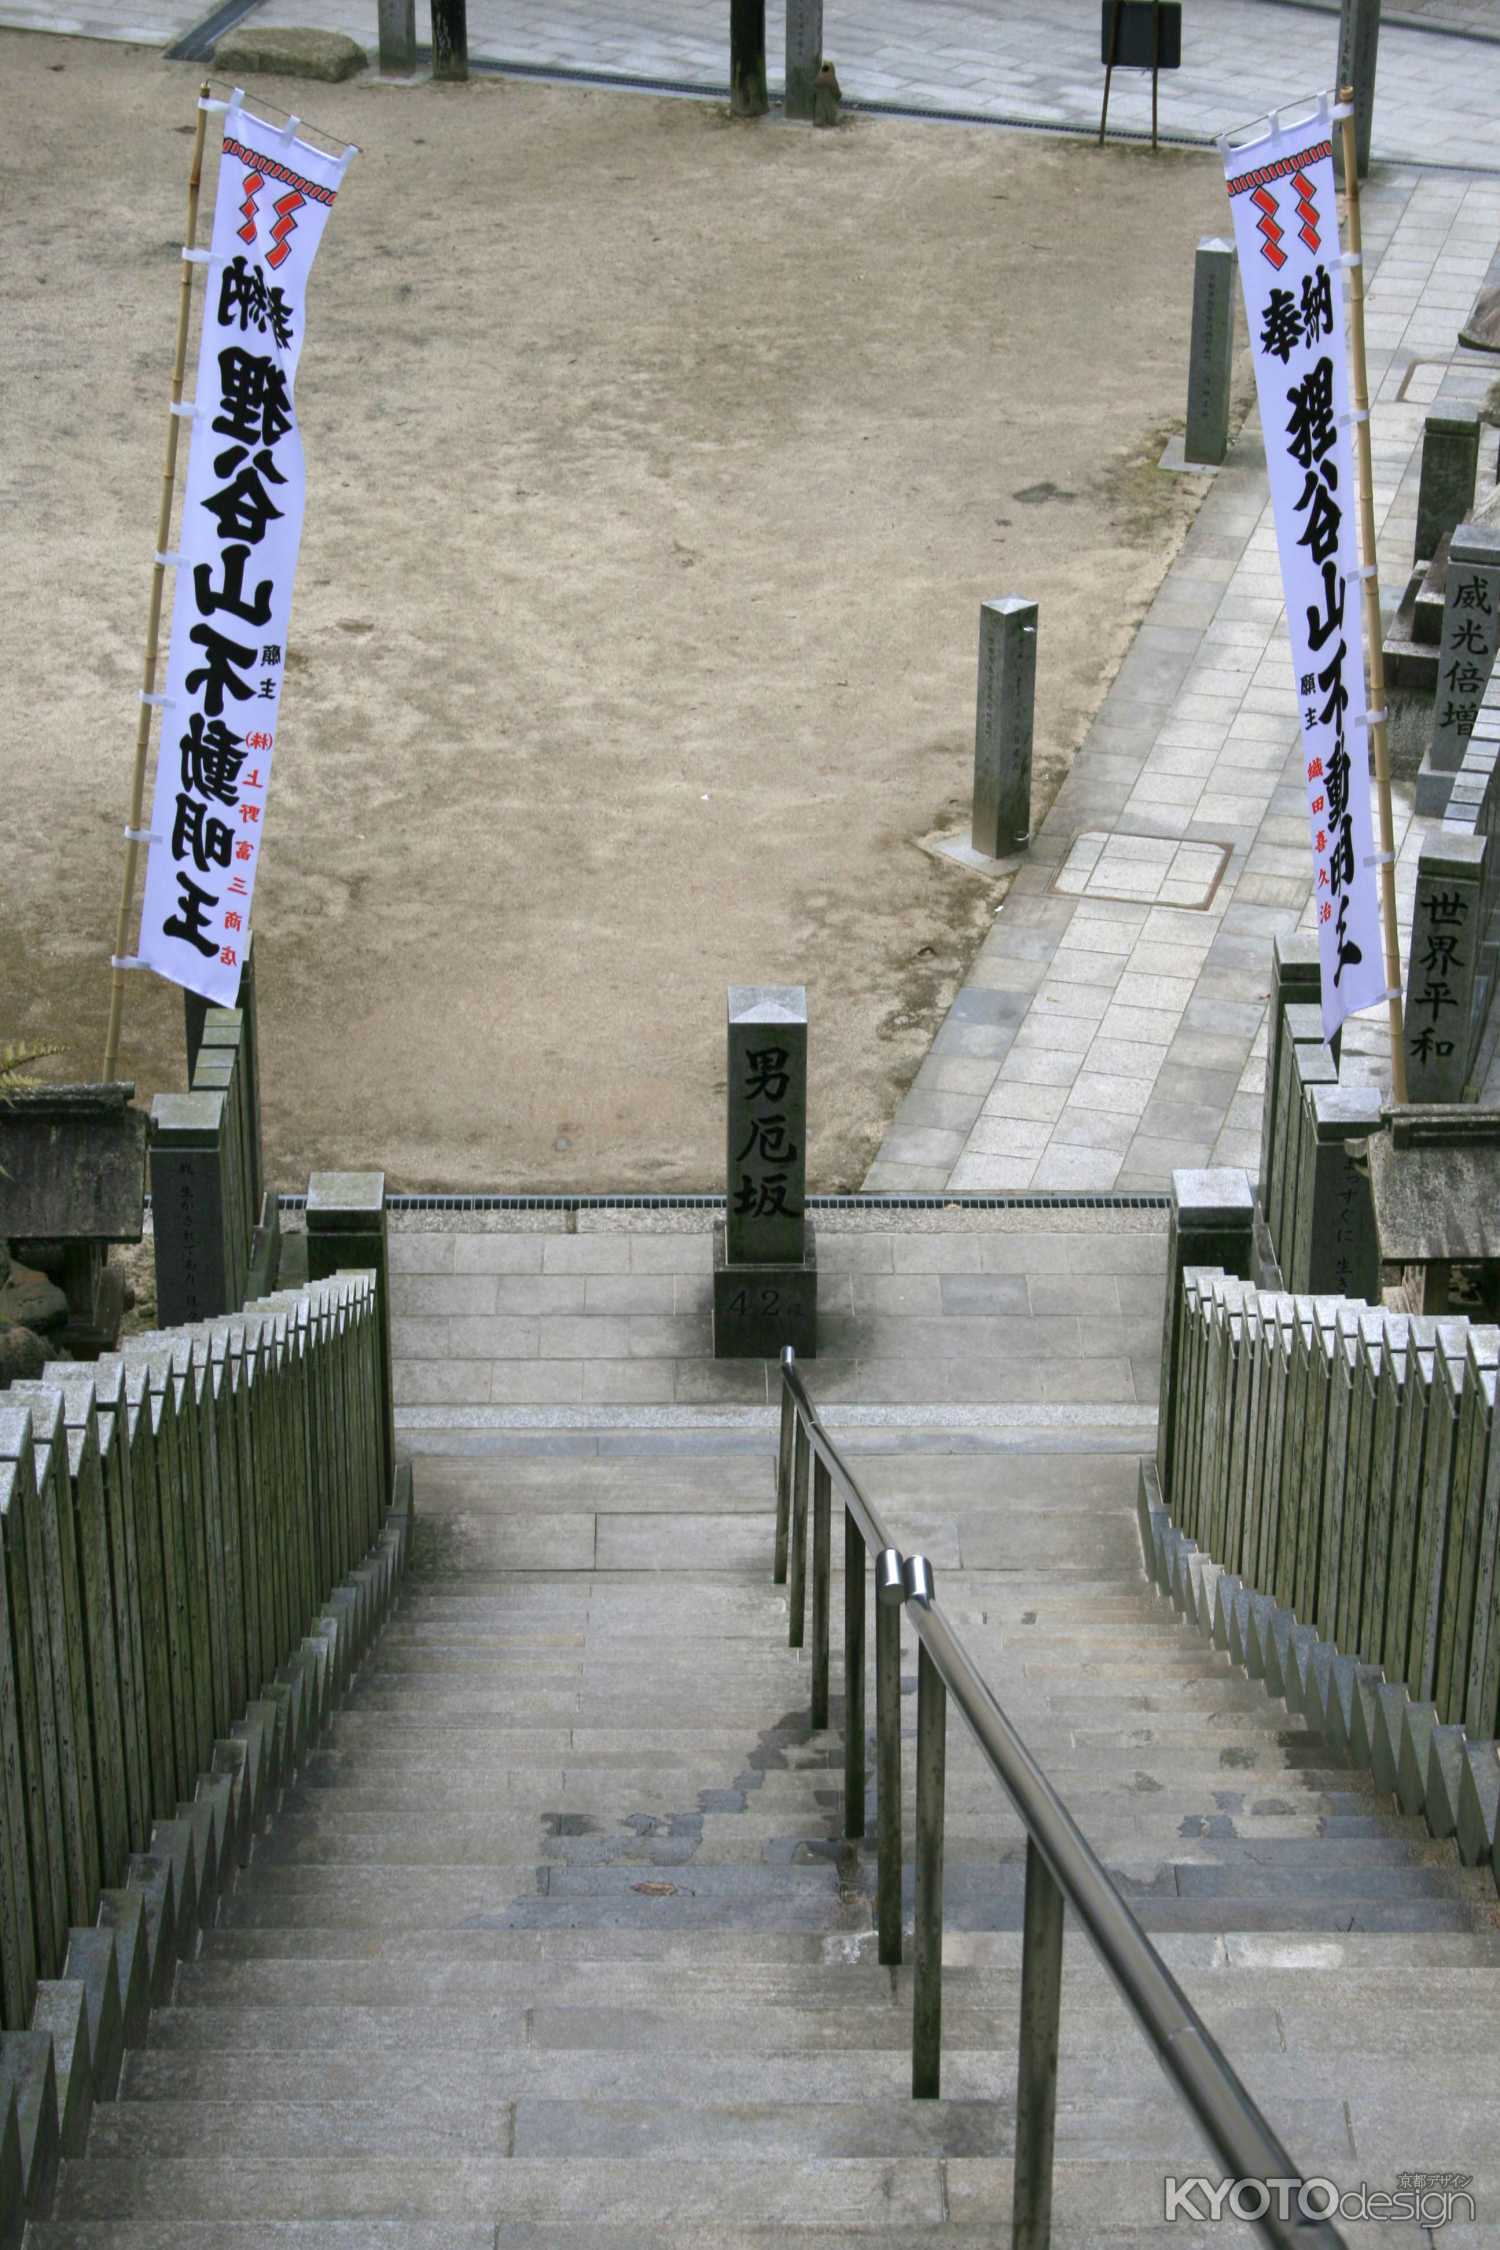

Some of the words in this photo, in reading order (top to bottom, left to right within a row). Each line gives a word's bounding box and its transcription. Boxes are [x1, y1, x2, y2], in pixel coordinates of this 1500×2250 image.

[1260, 264, 1334, 365] 奉納
[1300, 672, 1318, 730] 願主
[1440, 575, 1492, 736] 威光倍増
[1410, 891, 1469, 1064] 世界平和
[734, 1047, 801, 1218] 男厄坂
